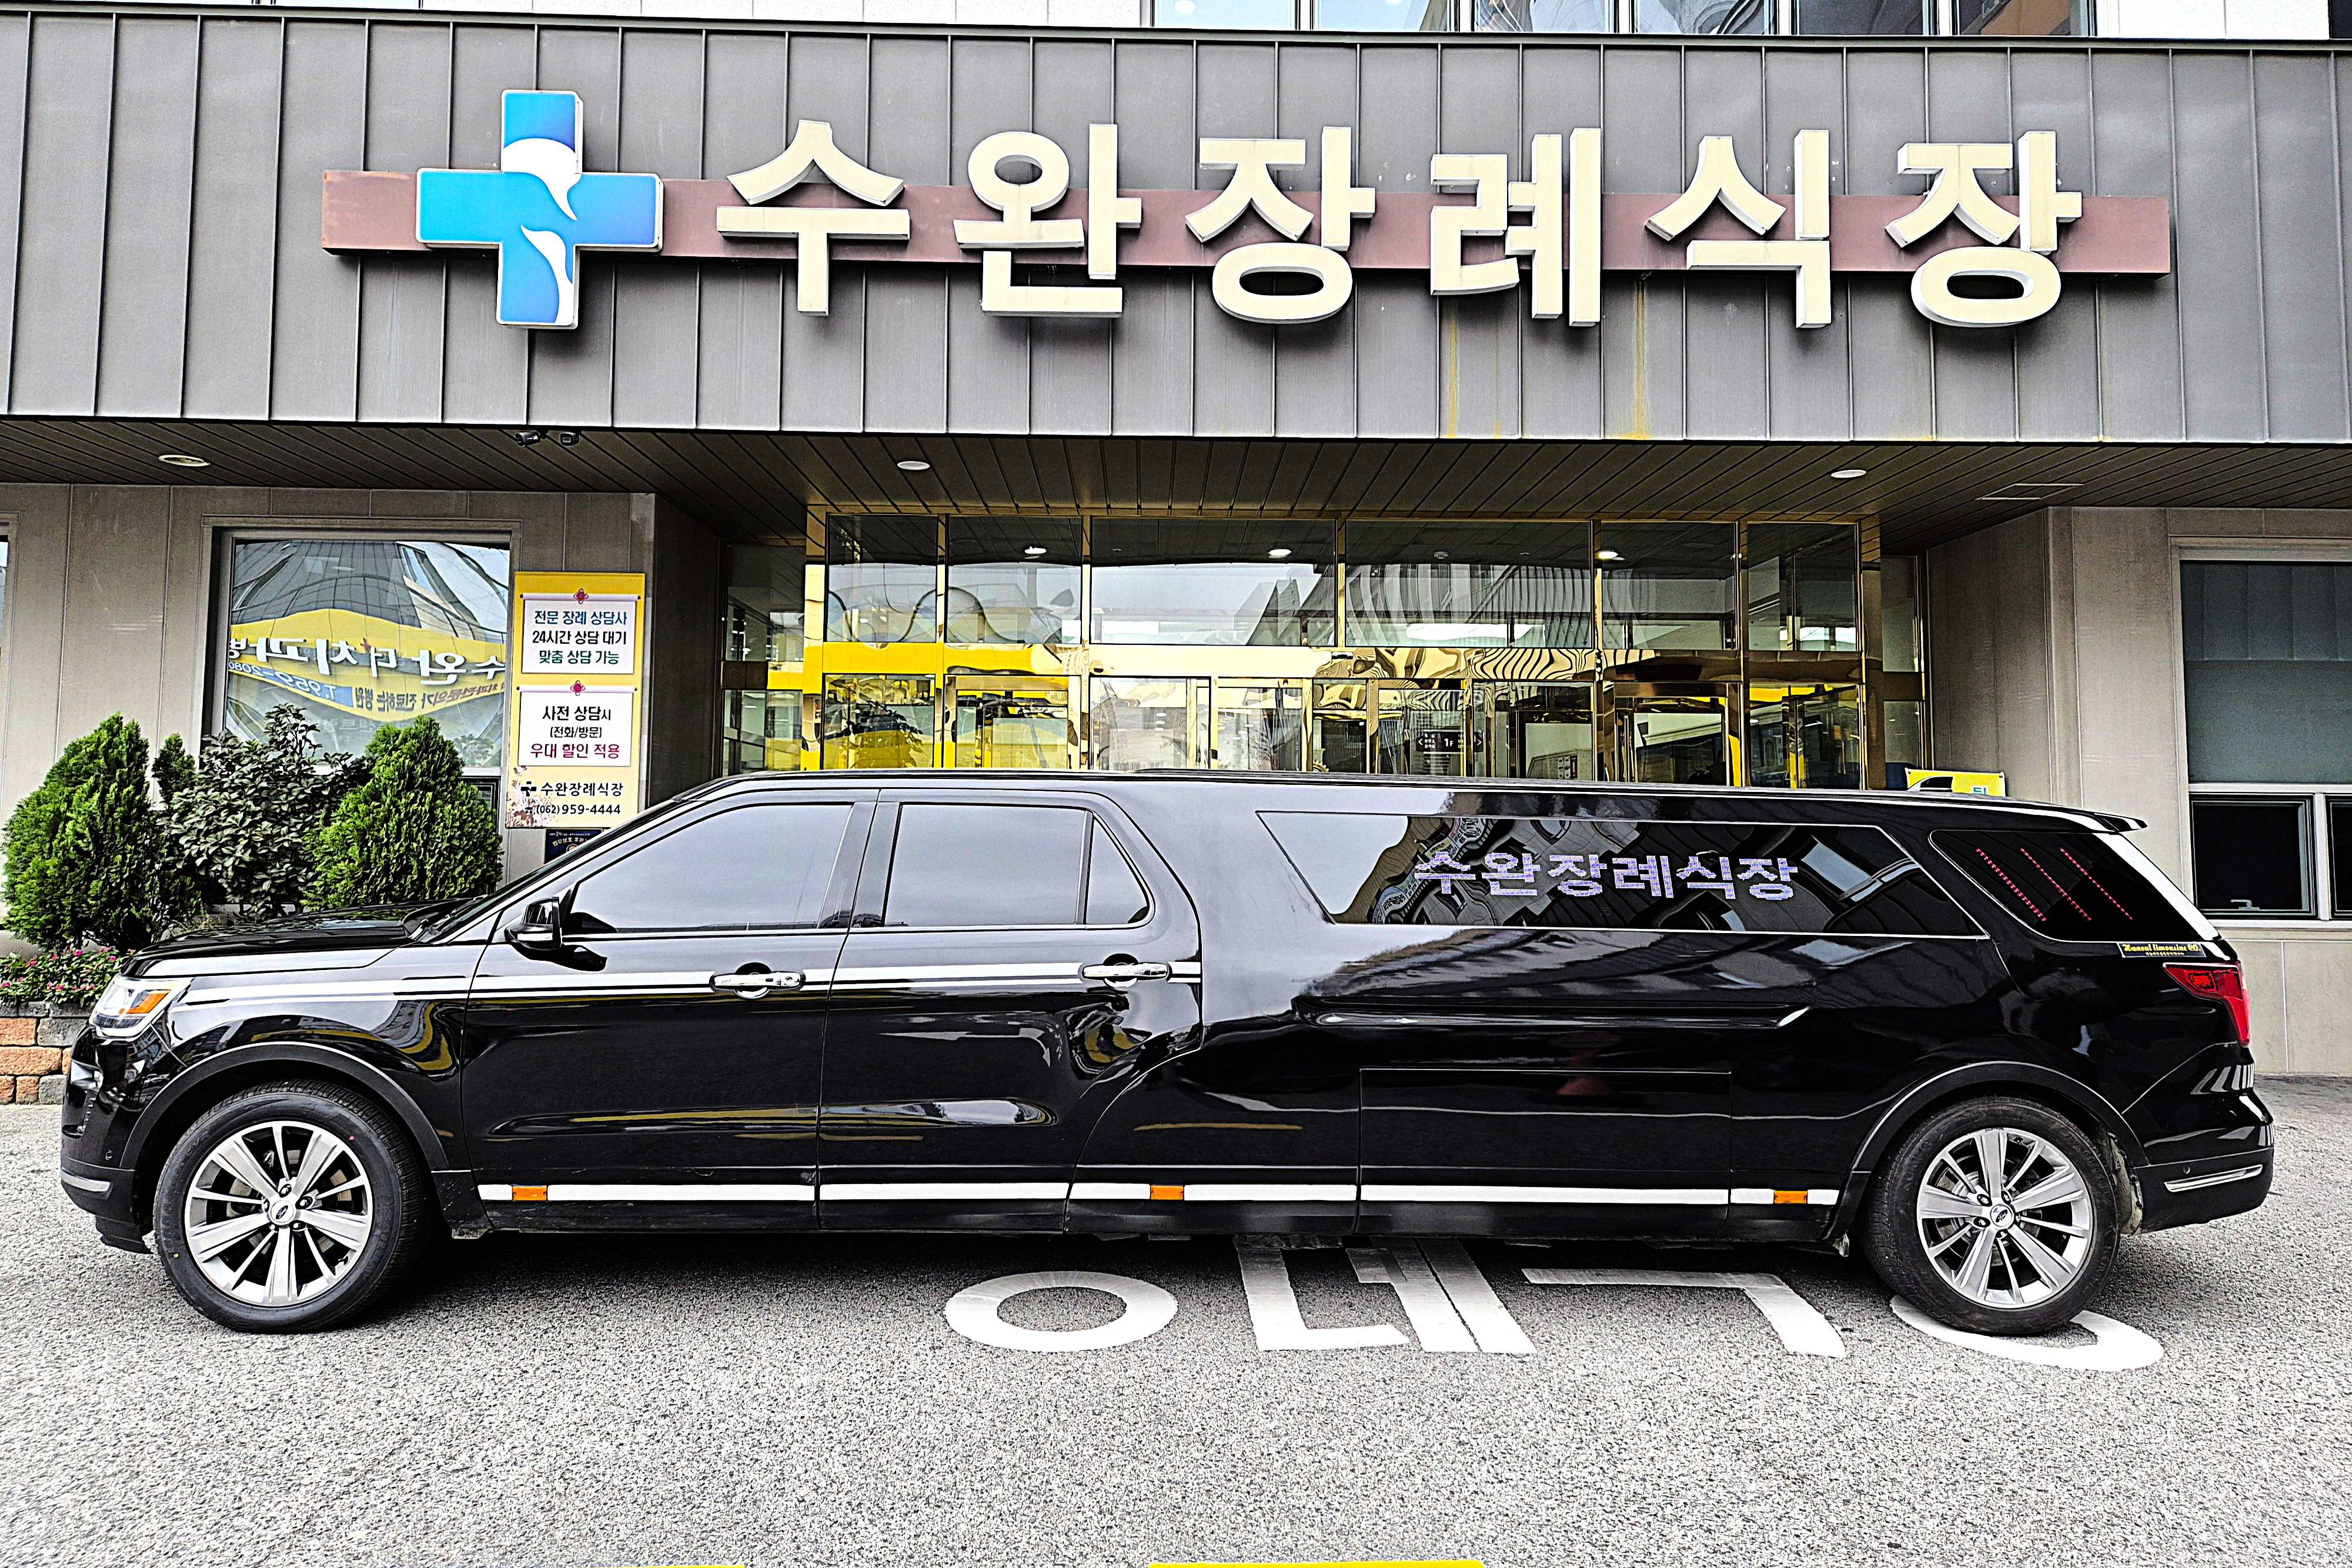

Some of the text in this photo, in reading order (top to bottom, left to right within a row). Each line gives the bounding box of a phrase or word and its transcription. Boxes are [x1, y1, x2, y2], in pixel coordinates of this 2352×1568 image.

[715, 118, 2083, 330] 수완장례식장
[534, 610, 627, 625] 전문 장례 상담사
[532, 630, 627, 645] 24시간 상담 대기
[539, 650, 619, 664] 맞춤 상담 가능
[542, 706, 611, 721] 사전 상담시
[530, 743, 620, 758] 우대 할인 적용
[540, 782, 624, 796] 수완장례식장
[1414, 851, 1799, 900] 수완장례식장
